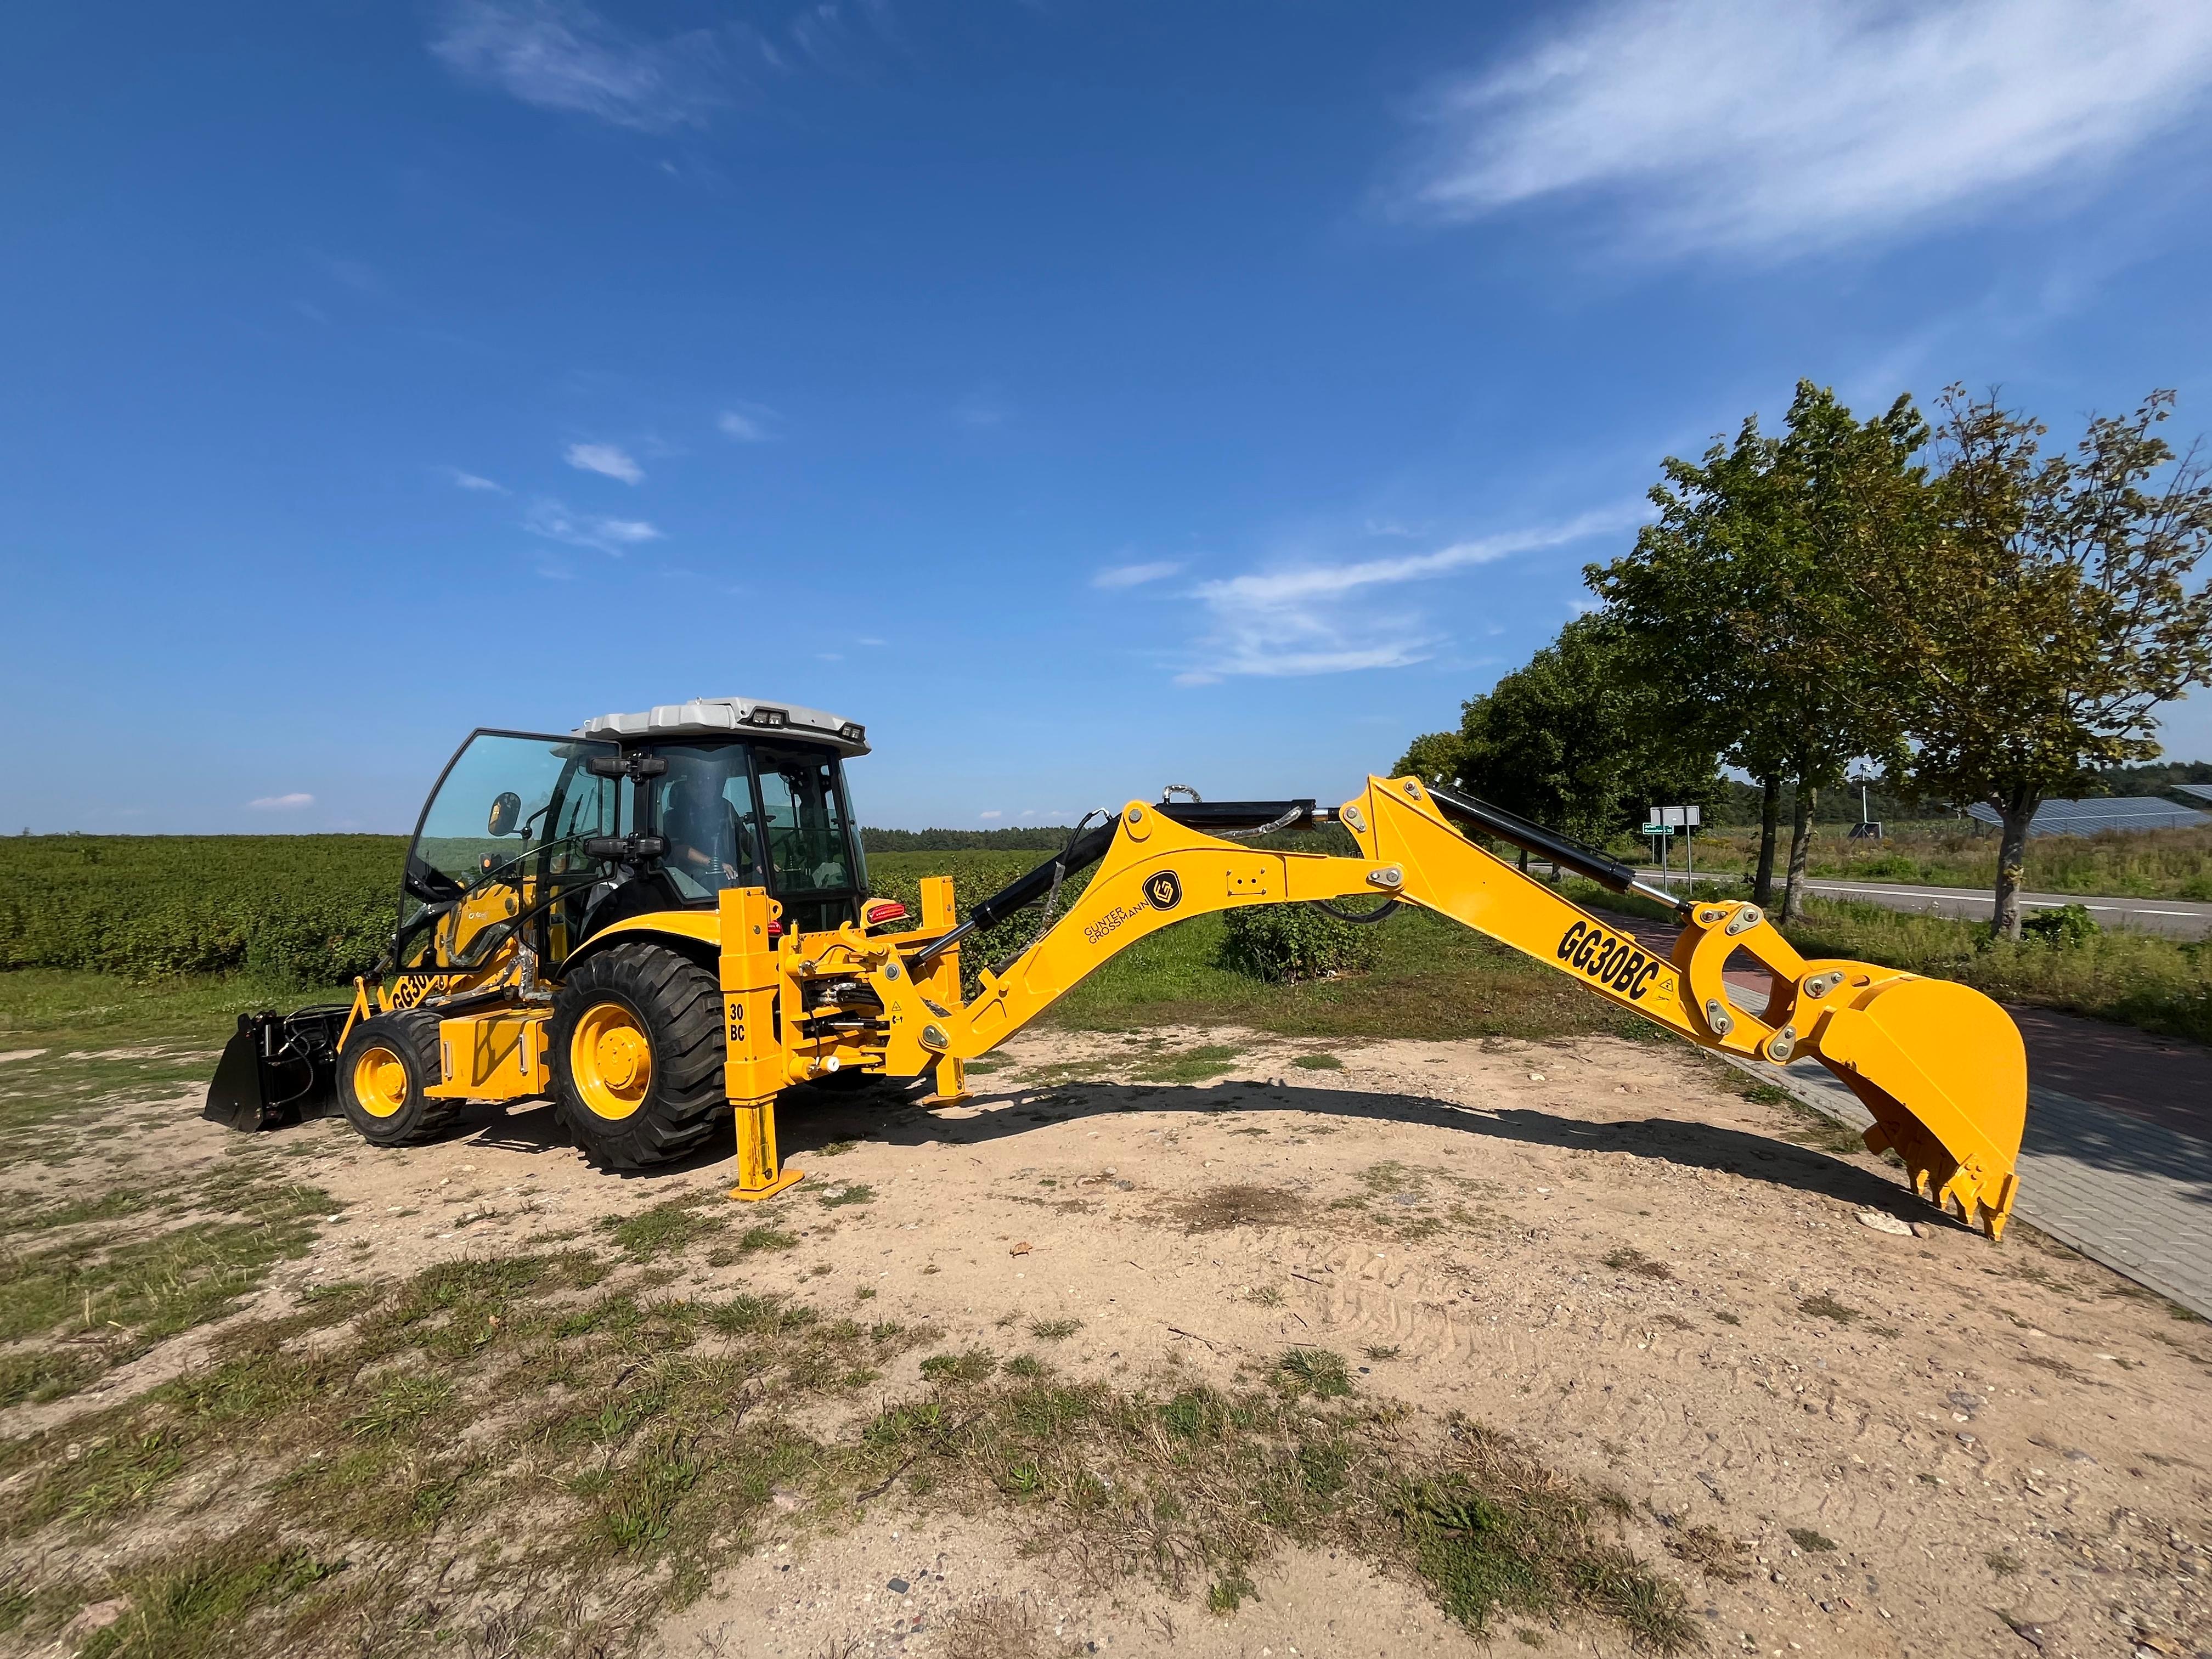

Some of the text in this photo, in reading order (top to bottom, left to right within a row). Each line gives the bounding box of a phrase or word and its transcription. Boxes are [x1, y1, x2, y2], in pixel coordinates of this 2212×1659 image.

[1084, 906, 1125, 936] GÜNTER
[1088, 899, 1149, 944] GROSSMANN
[1557, 921, 1660, 1001] GG30BC
[730, 1003, 743, 1021] 30
[730, 1024, 745, 1041] BC
